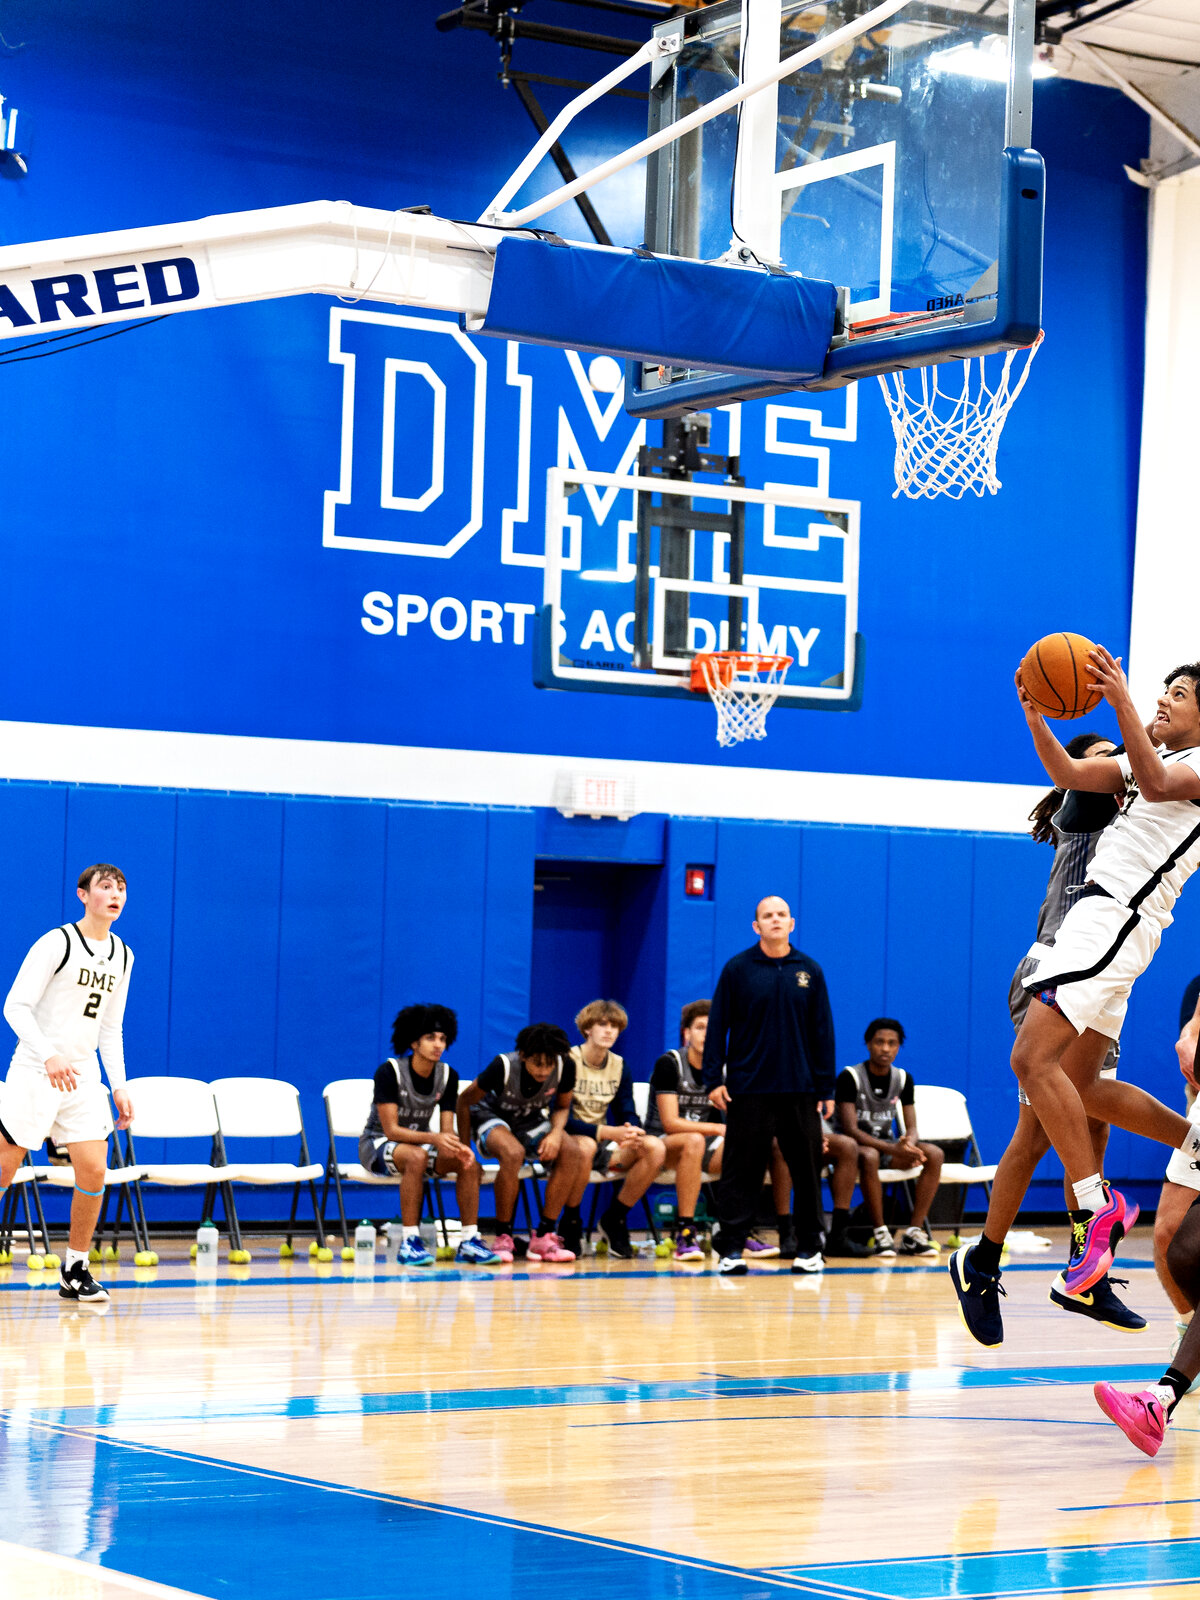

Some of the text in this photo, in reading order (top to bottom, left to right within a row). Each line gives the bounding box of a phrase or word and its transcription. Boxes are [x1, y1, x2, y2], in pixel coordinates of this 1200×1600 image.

[585, 779, 618, 806] EXIT
[77, 967, 116, 993] DME
[83, 992, 102, 1019] 2
